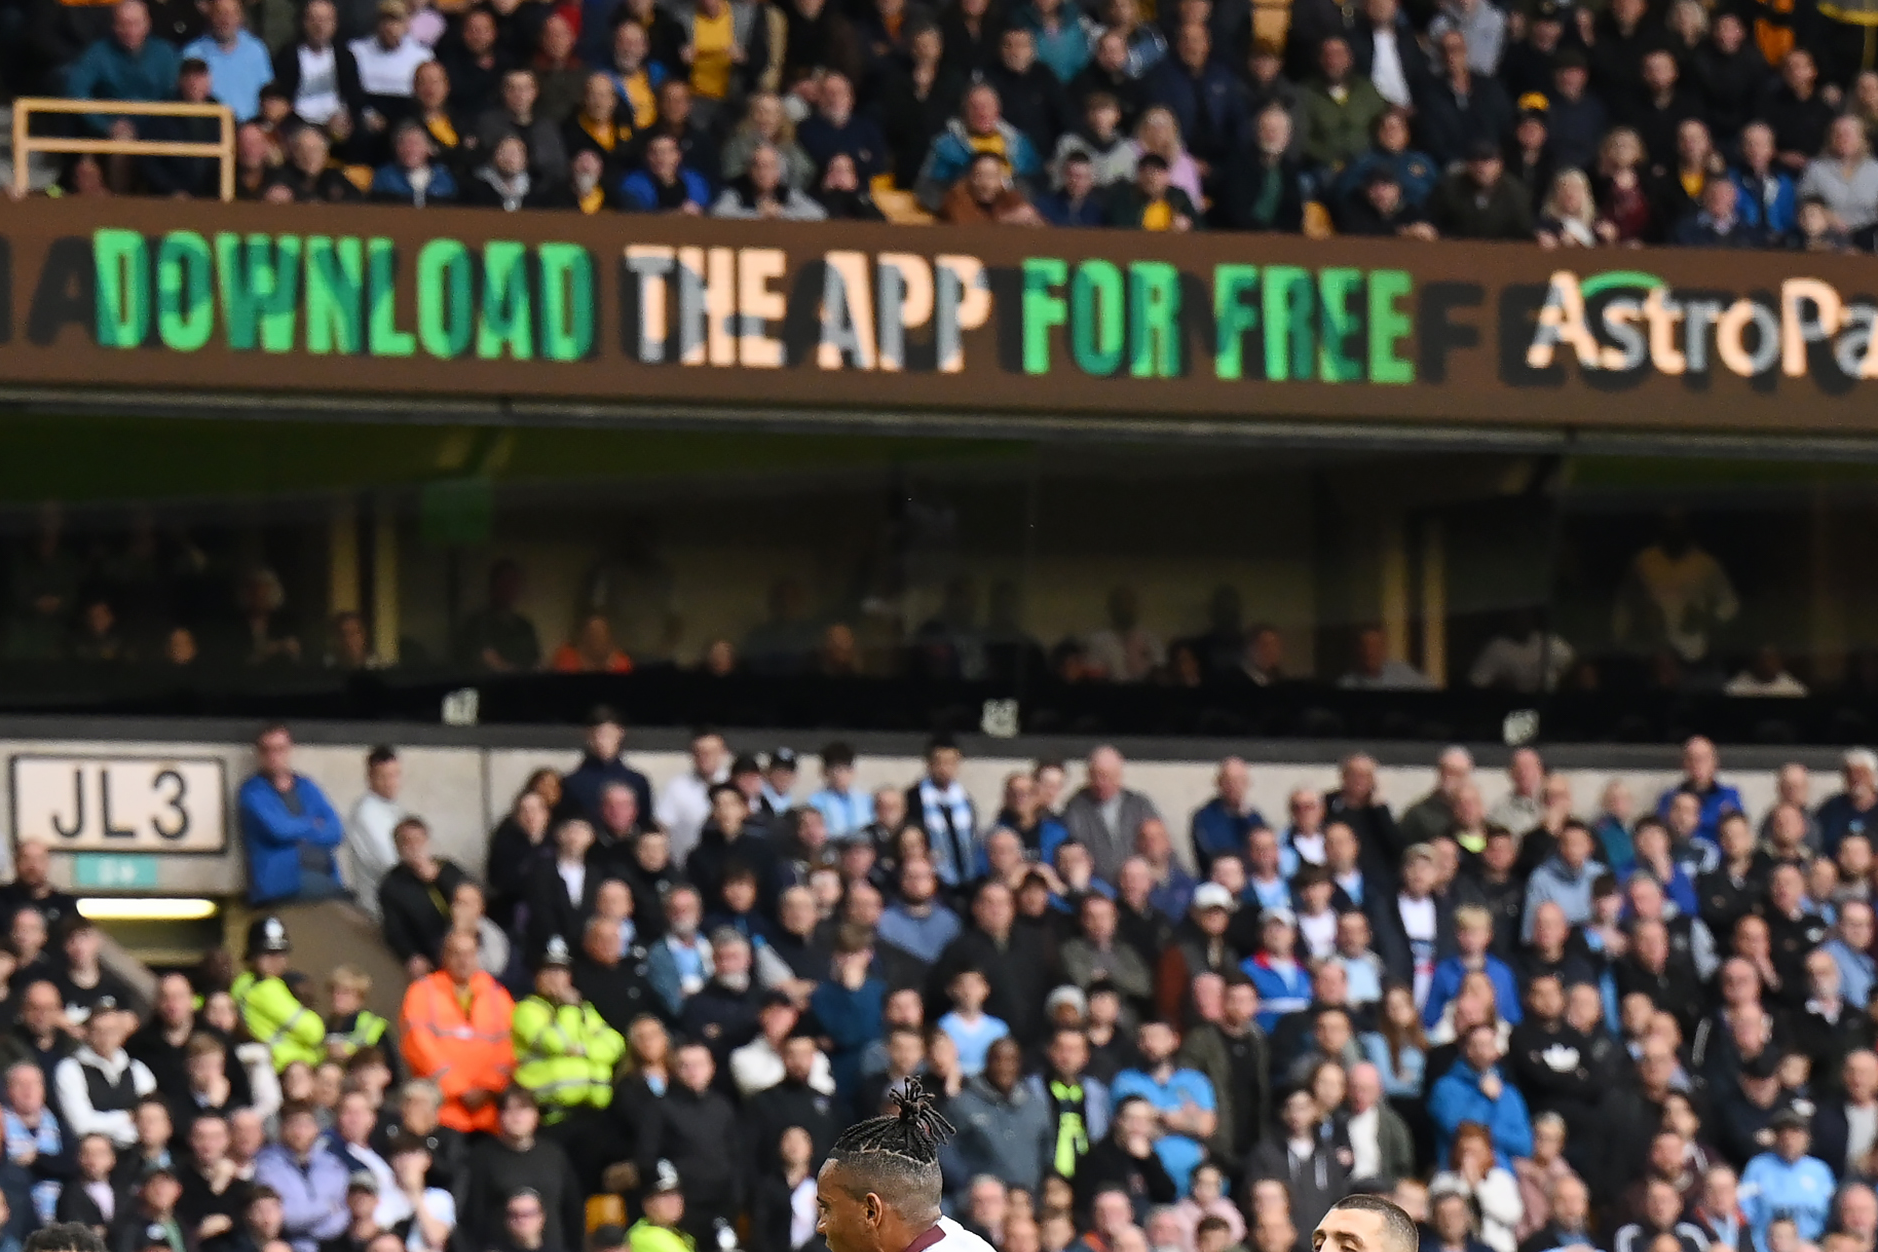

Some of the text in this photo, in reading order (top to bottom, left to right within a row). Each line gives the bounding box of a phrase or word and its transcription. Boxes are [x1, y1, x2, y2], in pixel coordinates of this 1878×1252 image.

[92, 228, 596, 362] DOWNLOAD
[624, 244, 787, 369] THE
[816, 250, 993, 373] APP
[1022, 257, 1182, 378] FOR
[1213, 264, 1415, 384] FREE
[52, 769, 190, 841] JL3
